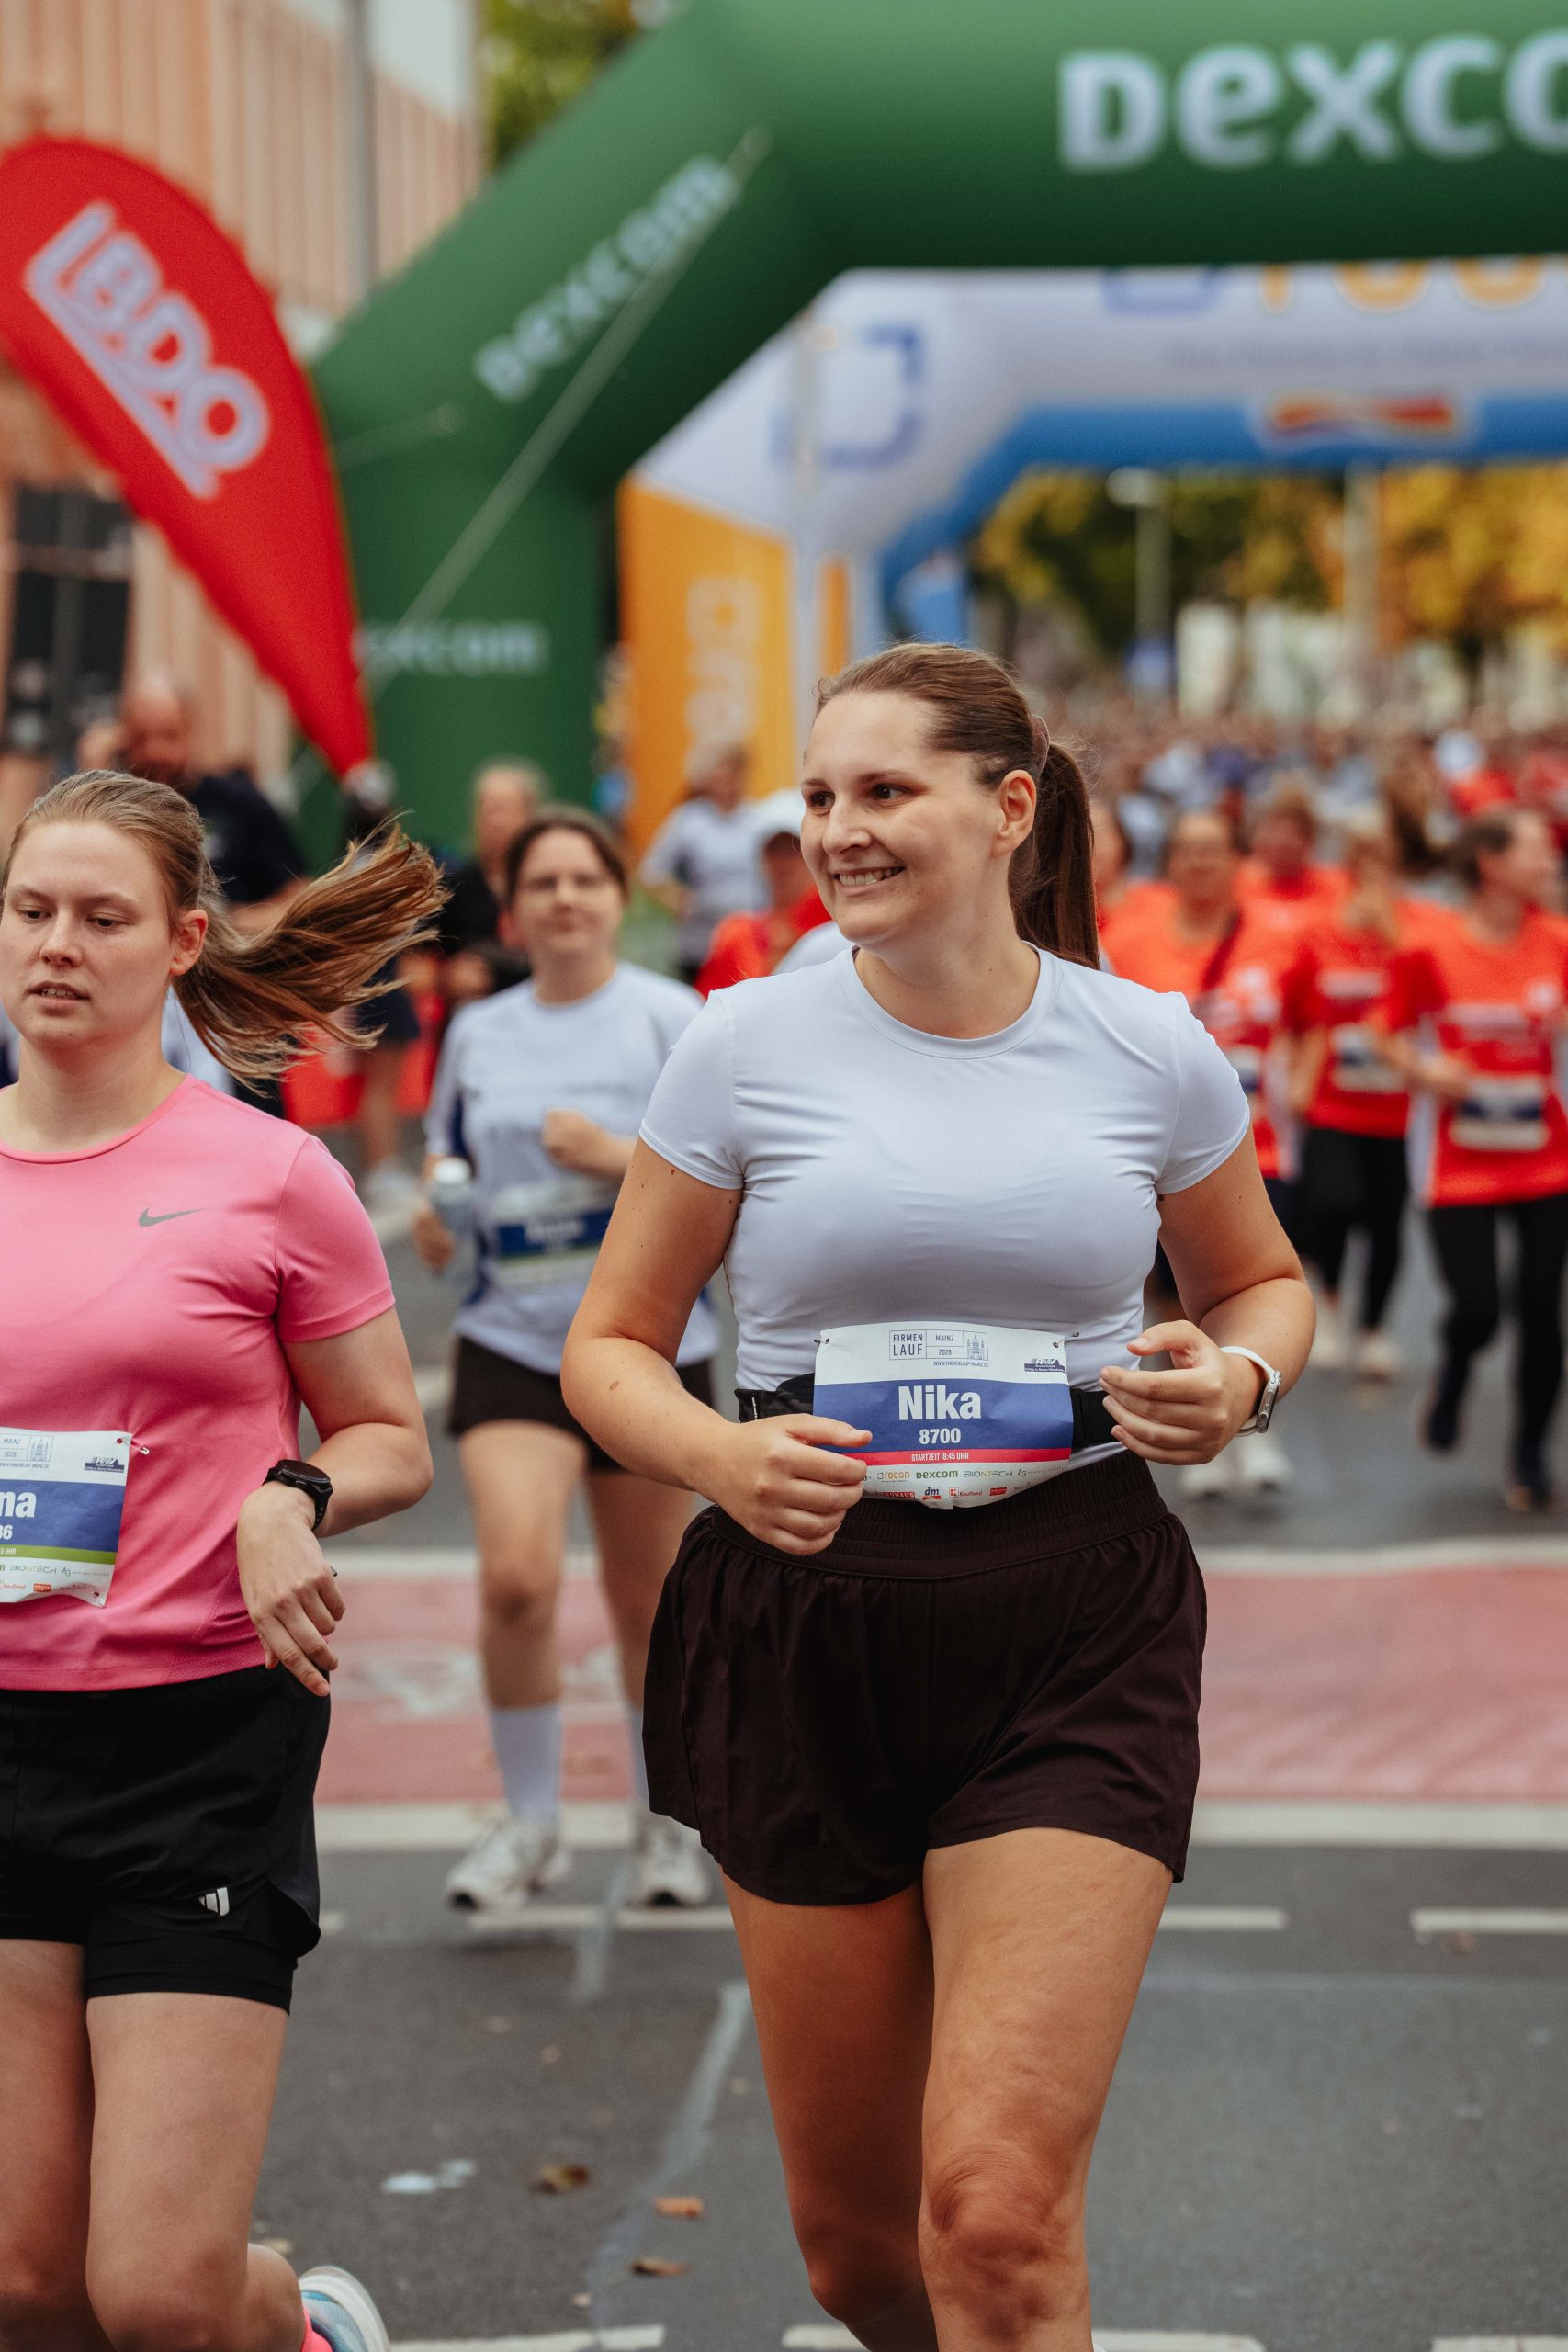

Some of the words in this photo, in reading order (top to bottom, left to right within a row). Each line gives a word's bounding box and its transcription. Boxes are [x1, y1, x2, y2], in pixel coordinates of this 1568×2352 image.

[893, 1334, 923, 1342] FIRMEN
[893, 1344, 923, 1356] LAUF
[898, 1385, 981, 1420] Nika
[919, 1428, 961, 1445] 8700
[925, 1487, 939, 1497] dm
[0, 1491, 37, 1517] na
